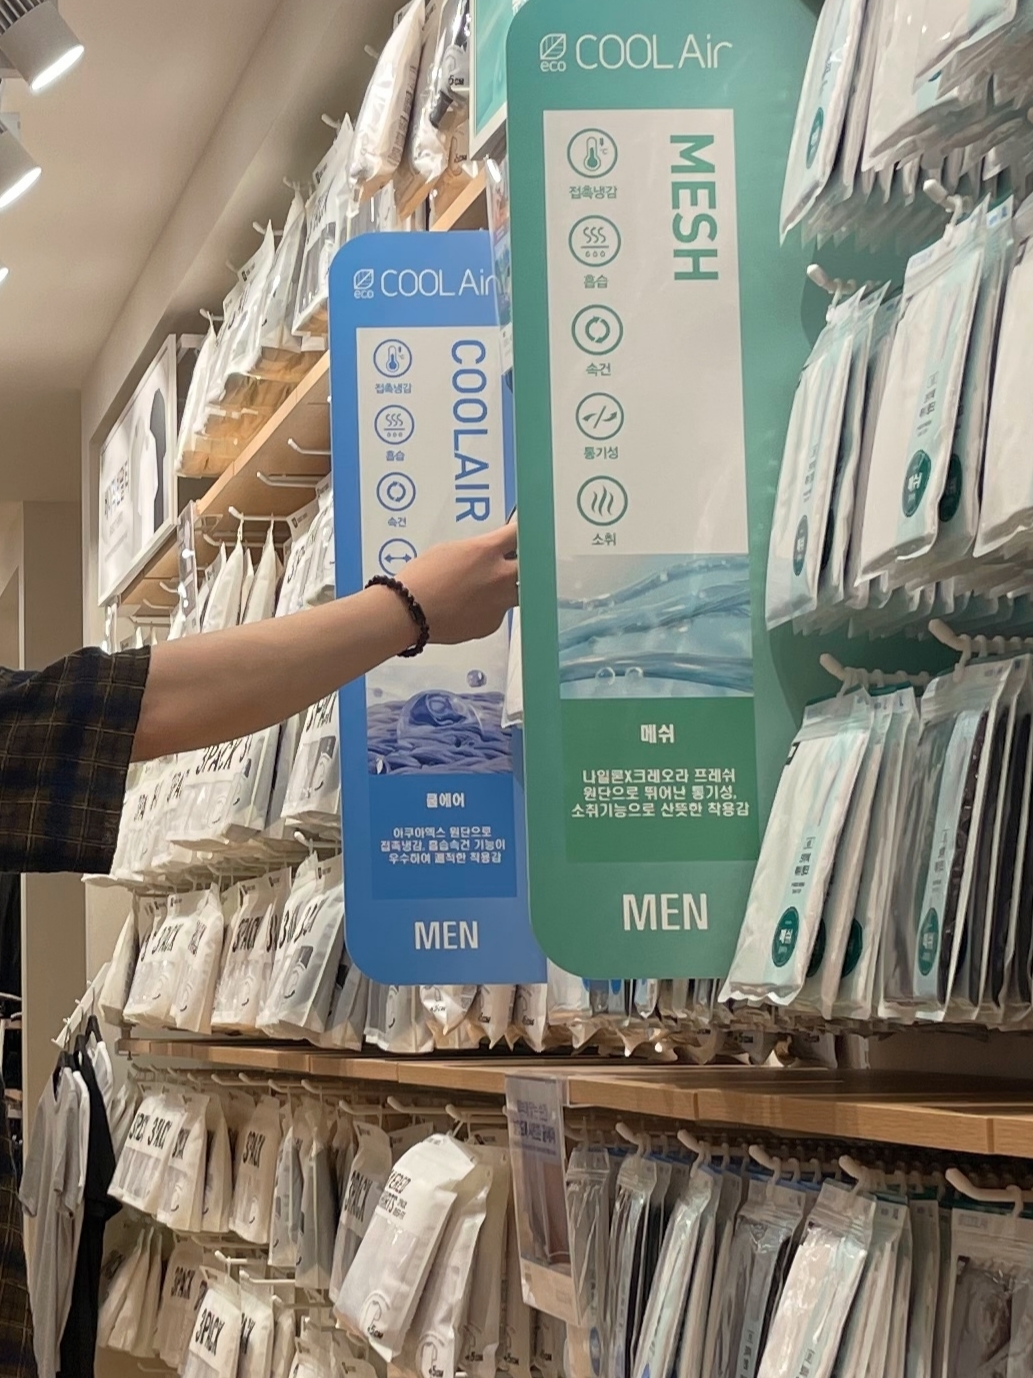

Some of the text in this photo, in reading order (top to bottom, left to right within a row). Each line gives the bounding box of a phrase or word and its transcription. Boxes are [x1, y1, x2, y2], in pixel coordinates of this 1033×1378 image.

[540, 60, 567, 72] eco
[569, 185, 617, 200] 접촉냉감
[670, 135, 719, 280] MESH
[584, 274, 608, 289] 흡습
[354, 289, 374, 299] eco
[586, 363, 611, 376] 속건
[375, 383, 412, 394] 접촉냉감
[451, 339, 490, 522] COOLAIR
[584, 447, 619, 460] 통기성
[388, 517, 407, 527] 속건
[592, 533, 617, 546] 소취
[640, 724, 675, 743] 메쉬
[582, 768, 736, 784] 나일론X크레오라 프레쉬
[426, 792, 465, 808] 쿨에어
[583, 786, 639, 801] 원단으로
[645, 786, 686, 800] 뛰어난
[571, 801, 750, 818] 소취기능으로 산뜻한 착용감
[393, 826, 492, 839] 아쿠아엑스 원단으로
[429, 839, 470, 851] 흡습속건
[474, 838, 506, 850] 기능이
[389, 852, 502, 864] 우수하여 쾌적한 착용감
[622, 893, 709, 931] MEN
[414, 920, 479, 950] MEN
[195, 1308, 226, 1356] 3PACK
